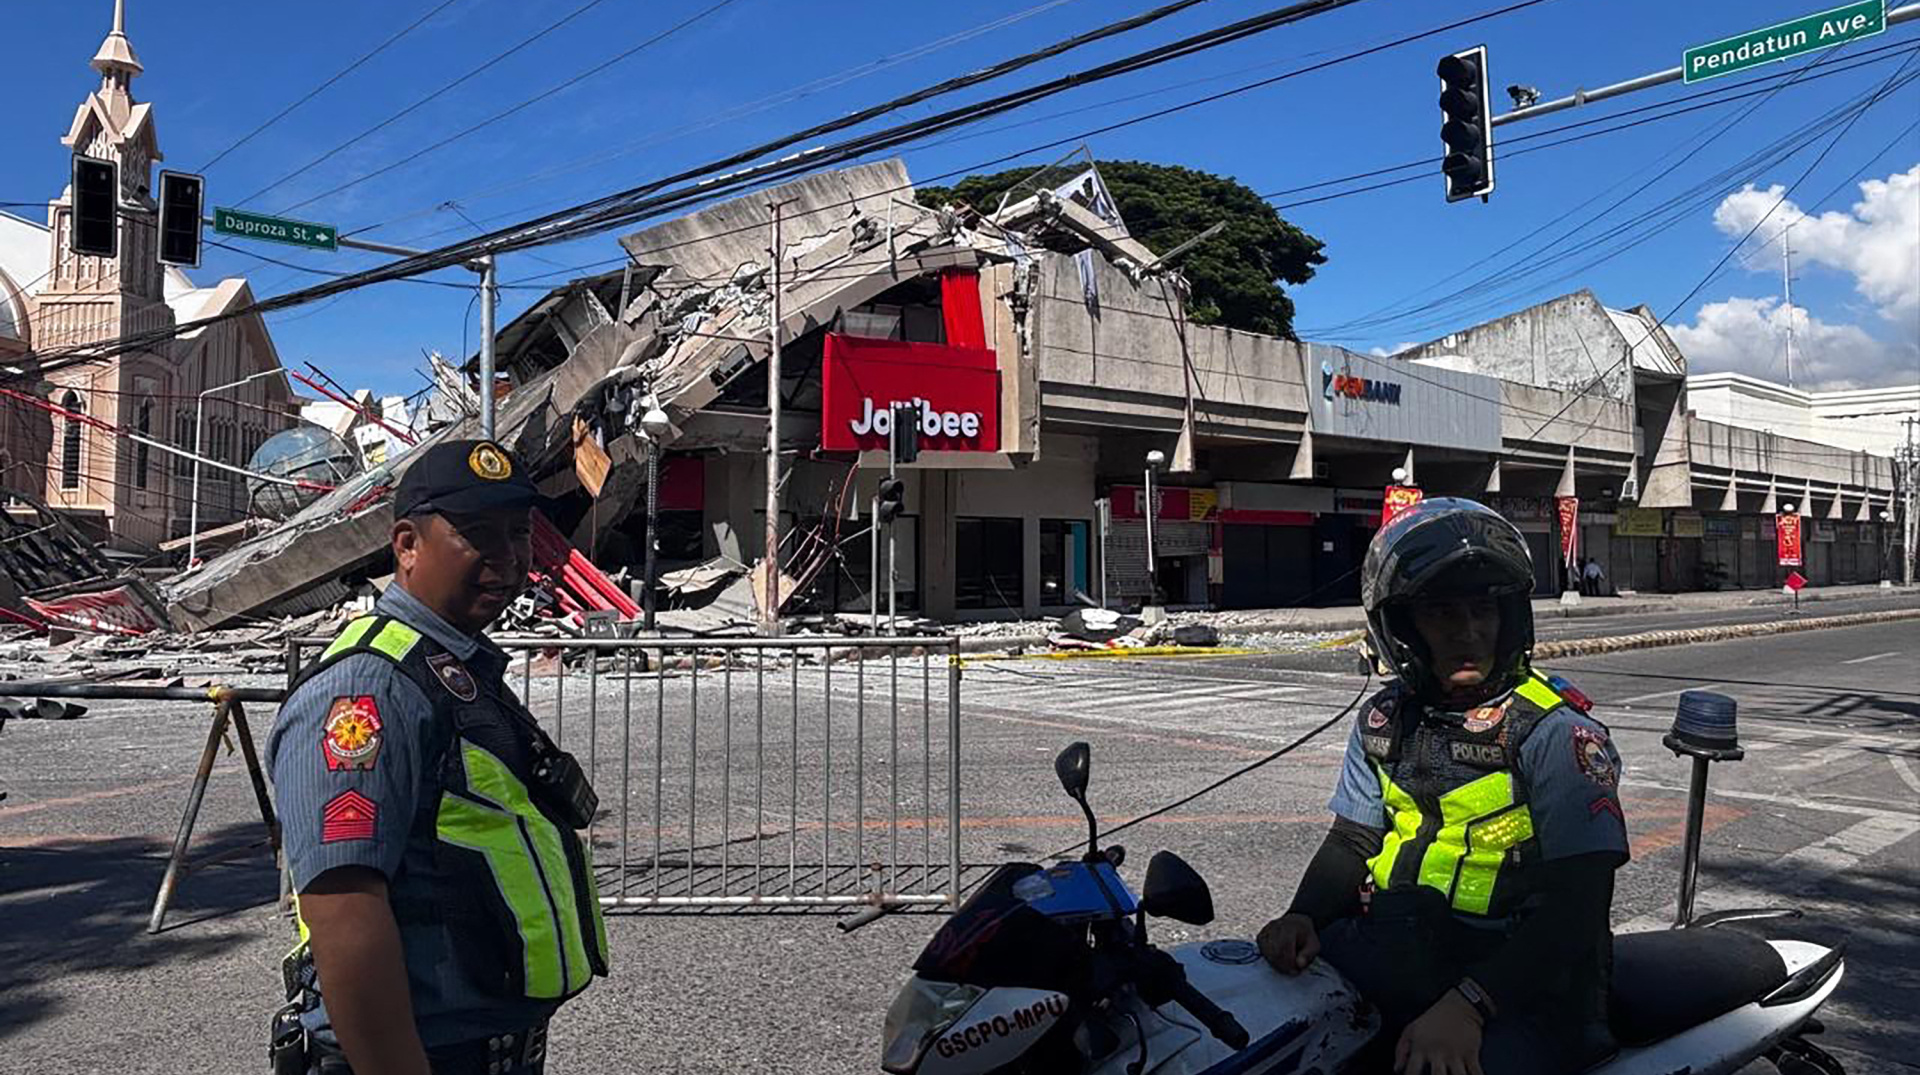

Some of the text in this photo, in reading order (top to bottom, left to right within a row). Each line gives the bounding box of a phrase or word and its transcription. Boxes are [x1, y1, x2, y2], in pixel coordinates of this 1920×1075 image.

[1693, 13, 1875, 73] Pendatun Ave.
[225, 216, 311, 241] Daproza St.
[1452, 743, 1502, 762] POLICE
[935, 994, 1064, 1059] GSCPO-MPU
